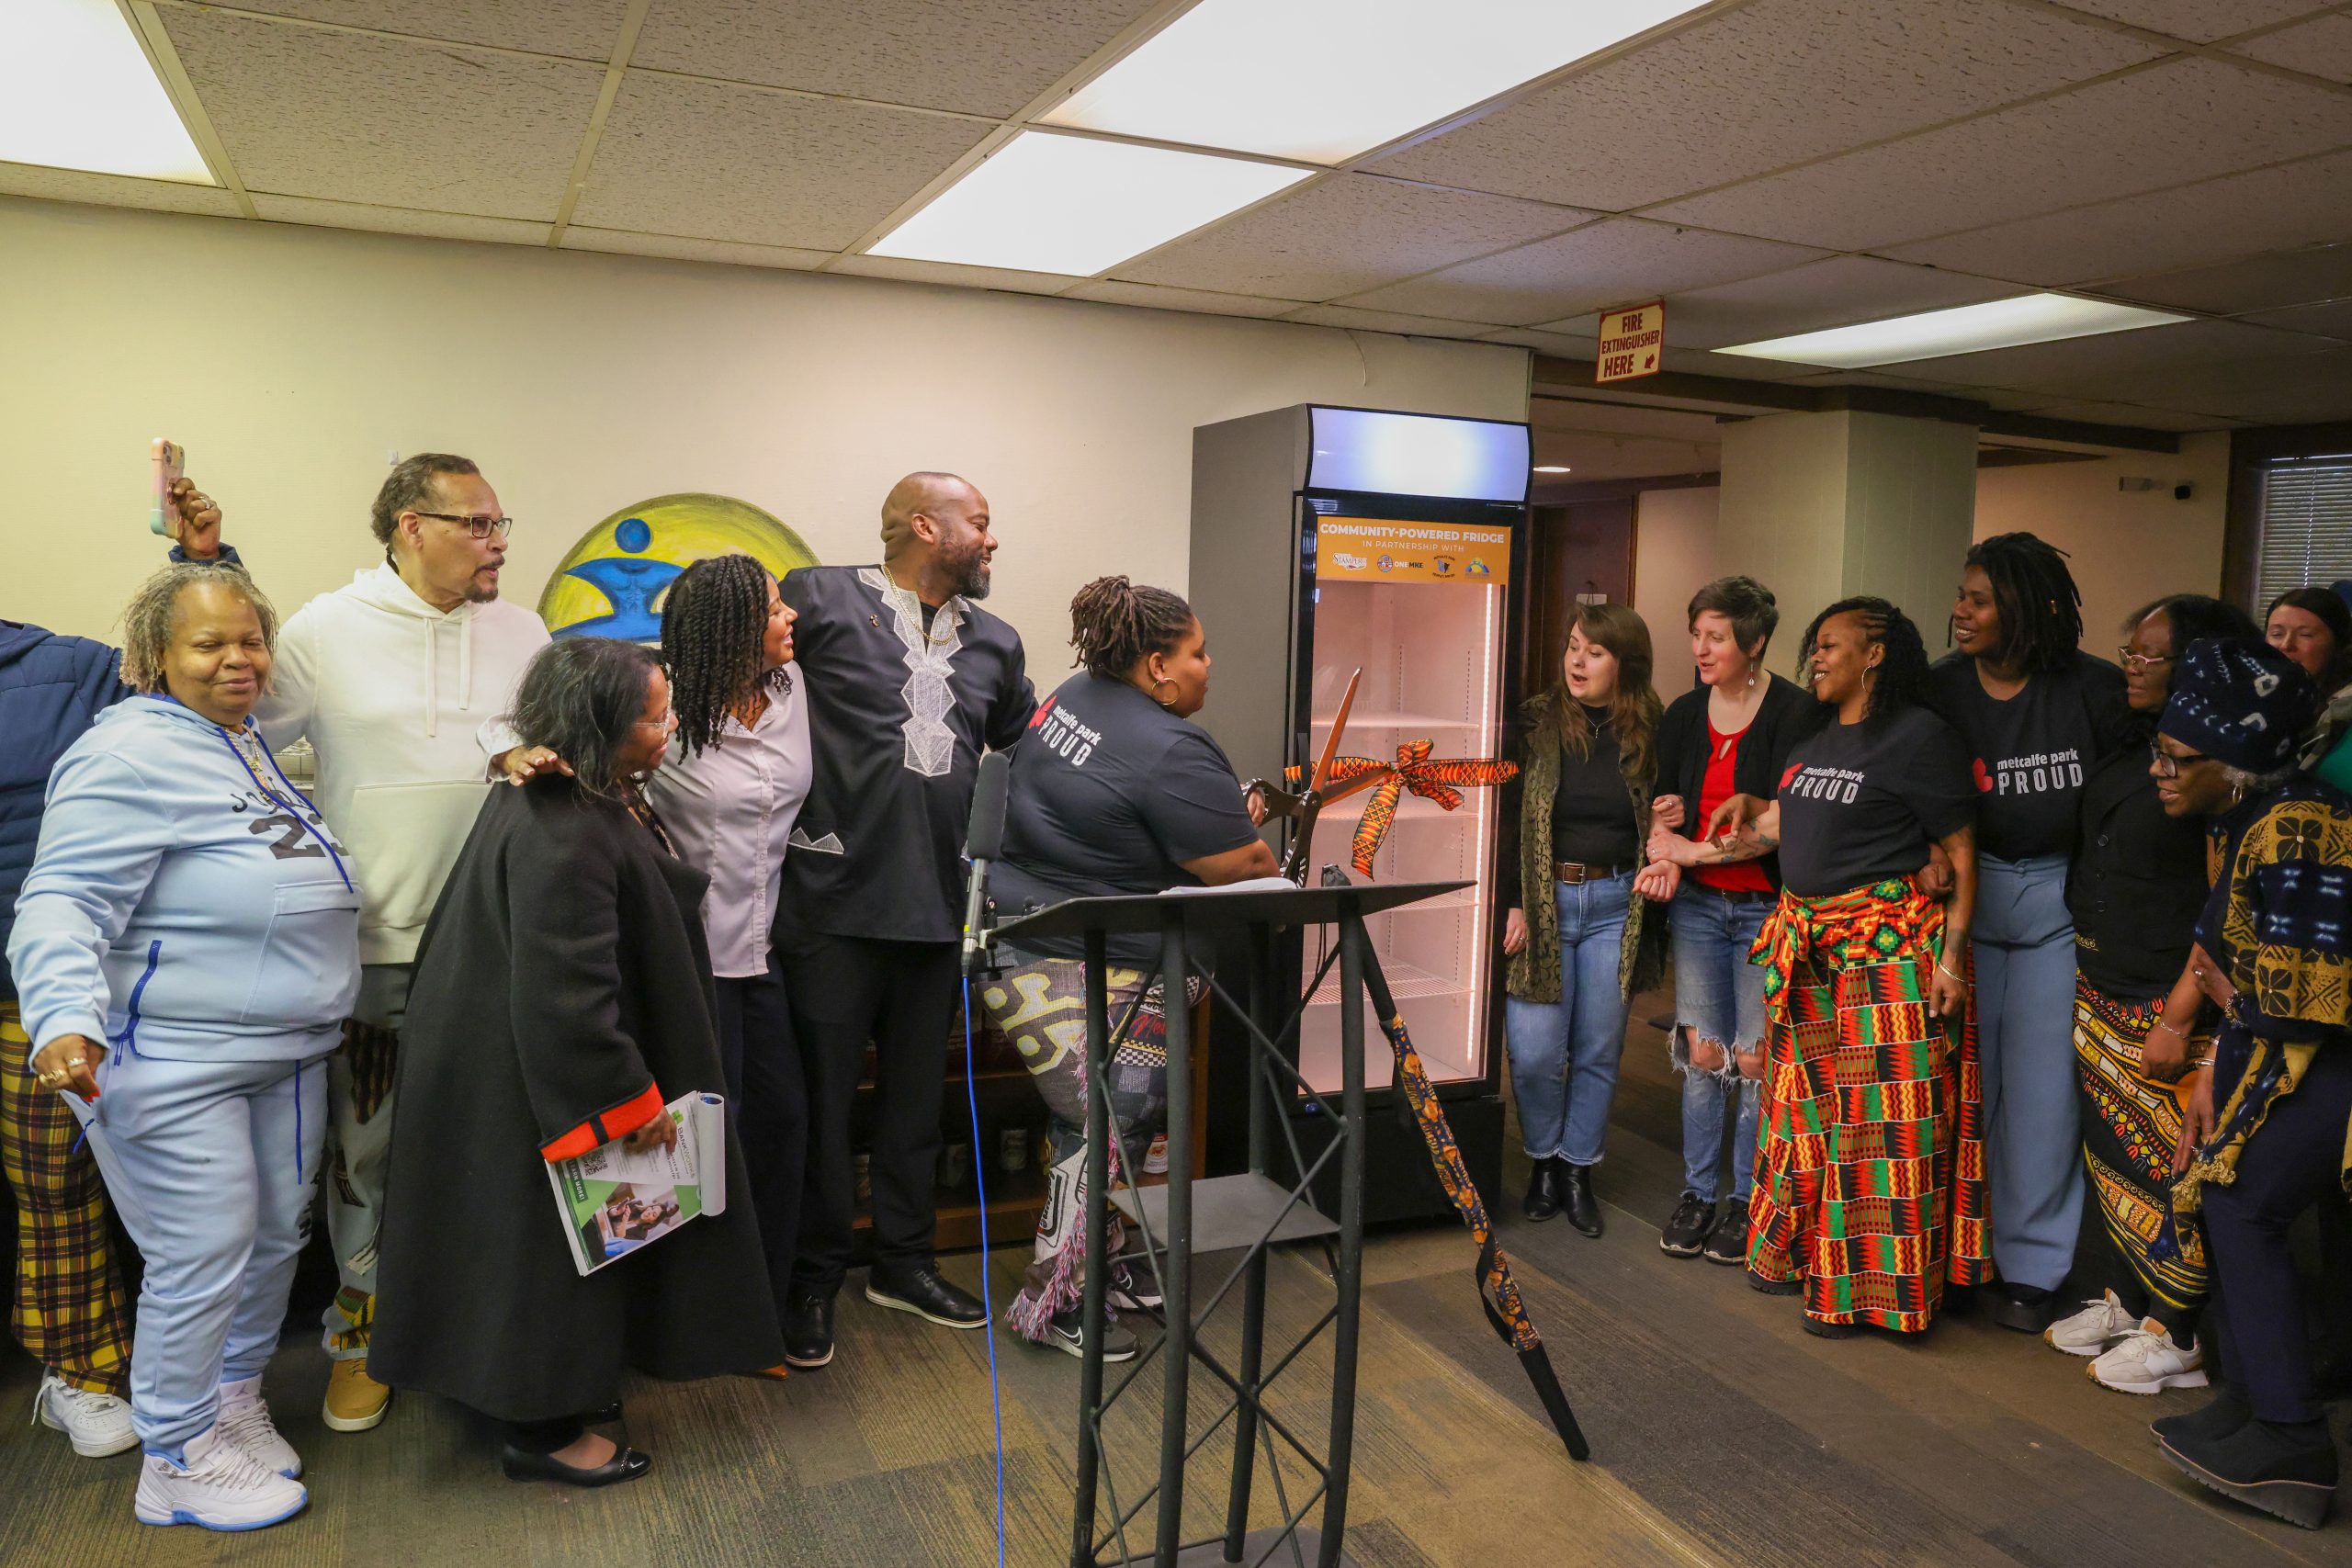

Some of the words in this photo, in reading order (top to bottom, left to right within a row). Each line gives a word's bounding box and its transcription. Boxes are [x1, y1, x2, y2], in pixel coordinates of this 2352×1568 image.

[1622, 312, 1643, 333] FIRE
[1601, 330, 1660, 355] EXTINGUISHER
[1603, 353, 1634, 378] HERE
[1319, 524, 1460, 541] COMMUNITY-POWERED
[1463, 531, 1505, 544] FRIDGE
[1375, 540, 1438, 551] PARTNERSHIP
[1441, 544, 1464, 552] WITH
[1053, 705, 1078, 729] metcalfe
[1075, 724, 1102, 746] park
[1038, 715, 1092, 766] PROUD
[1996, 753, 2048, 771] metcalfe
[2051, 748, 2079, 765] park
[1803, 766, 1838, 777] metcalfe
[1836, 769, 1865, 784] park
[1997, 763, 2084, 795] PROUD
[1790, 774, 1859, 805] PROUD
